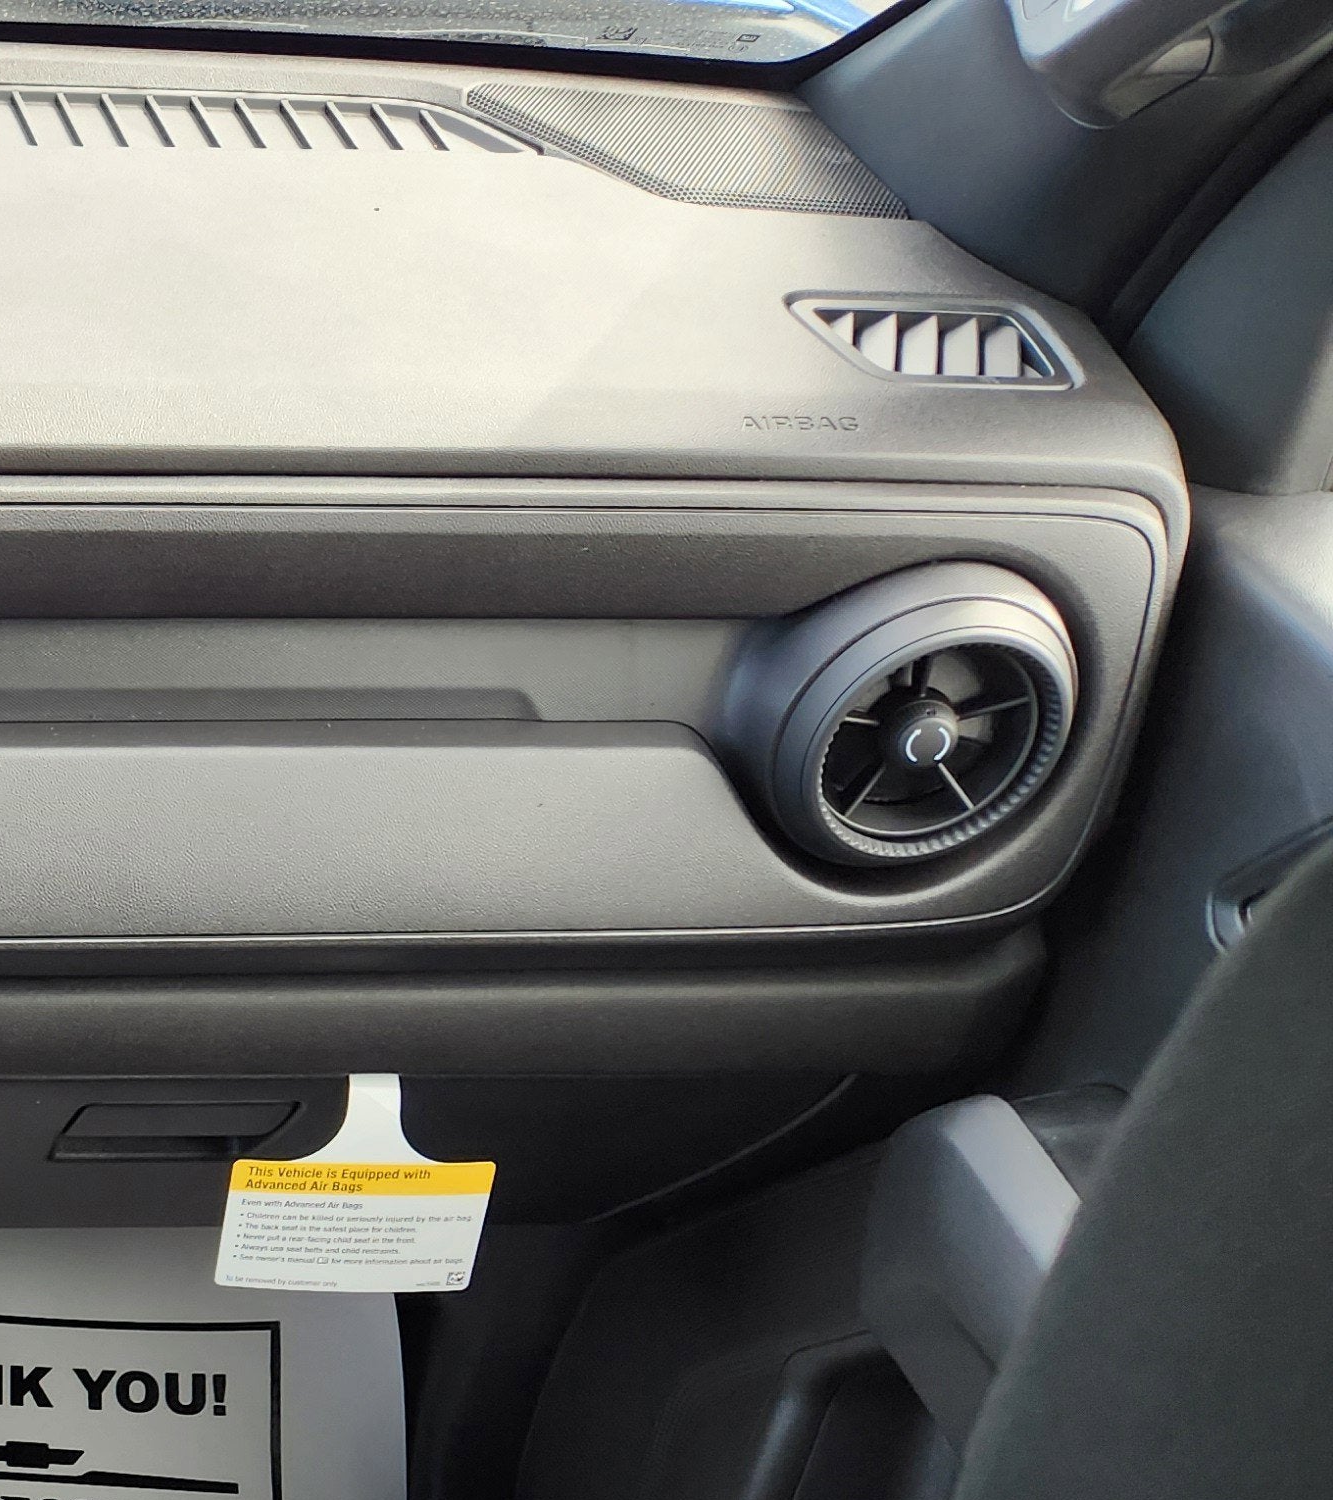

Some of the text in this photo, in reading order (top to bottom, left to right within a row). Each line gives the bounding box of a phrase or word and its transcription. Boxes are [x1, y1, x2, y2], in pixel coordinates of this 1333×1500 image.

[740, 415, 860, 431] AIRBAG
[249, 1166, 431, 1181] This Vehicle is Equipped with
[245, 1179, 363, 1193] Advanced Air Bags
[241, 1199, 363, 1210] Even with Advanced Air Bags
[246, 1212, 280, 1220] Children
[416, 1215, 425, 1223] by
[241, 1244, 268, 1252] Always
[73, 1369, 228, 1417] YOU!
